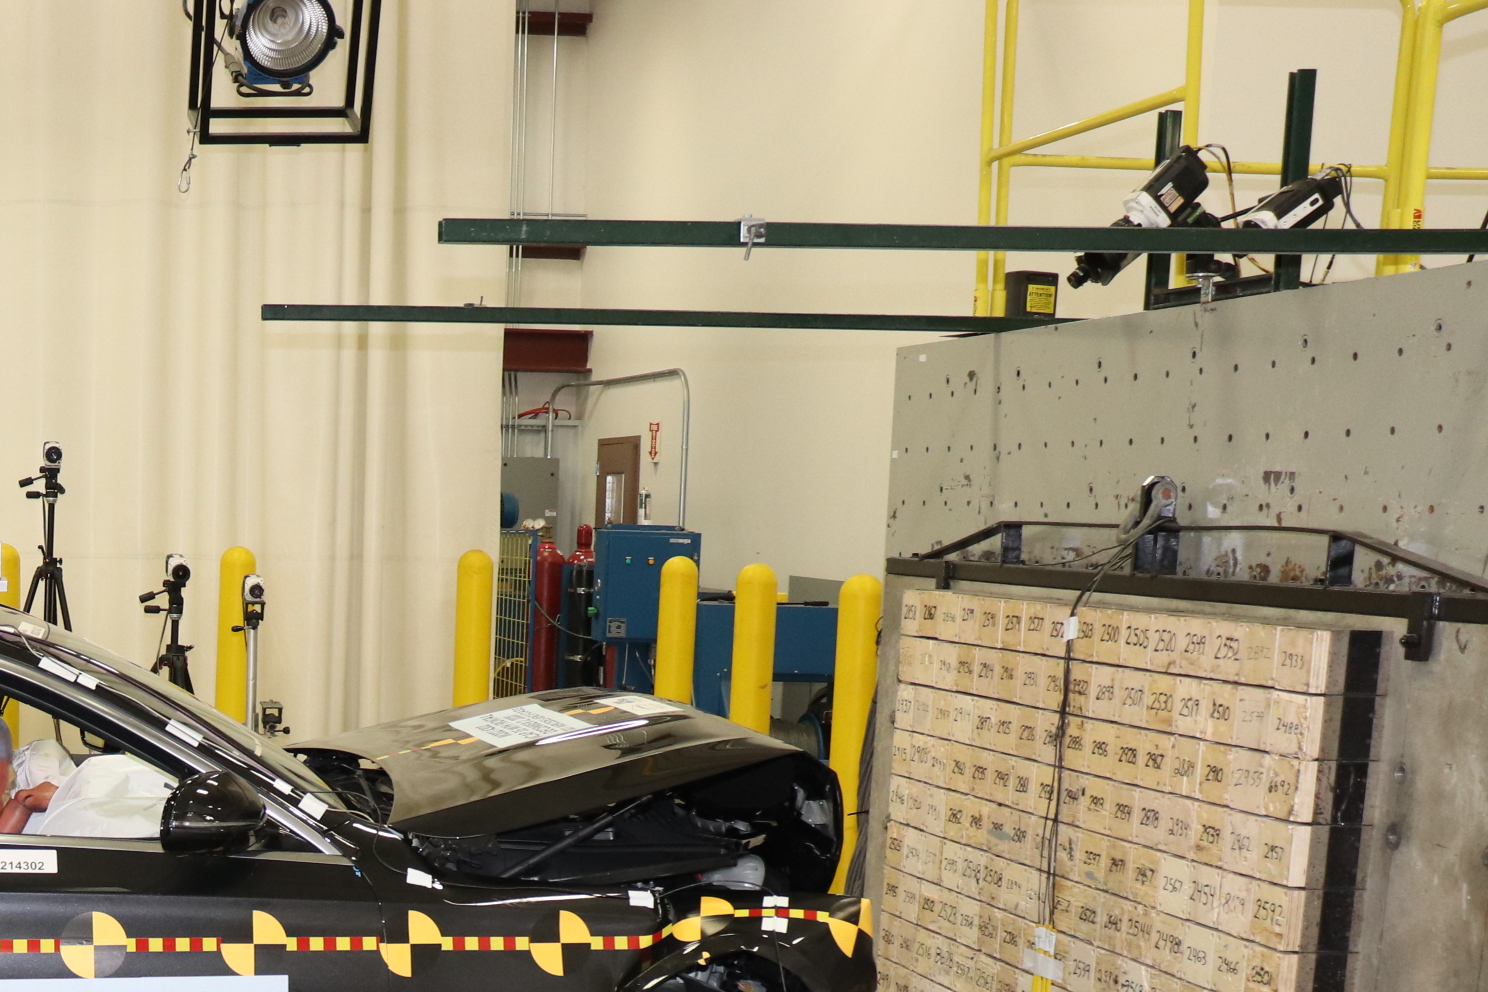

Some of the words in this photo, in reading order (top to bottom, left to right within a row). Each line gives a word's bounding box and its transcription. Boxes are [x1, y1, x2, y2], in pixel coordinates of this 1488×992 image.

[1100, 623, 1120, 643] 2500
[1125, 625, 1150, 649] 2505
[1154, 629, 1177, 653] 2520
[1214, 634, 1241, 661] 2552
[1281, 651, 1305, 670] 2933
[1150, 692, 1173, 713] 2530
[1179, 698, 1199, 717] 2519
[1118, 746, 1138, 765] 2928
[1205, 764, 1224, 783] 2910
[1234, 768, 1264, 788] 2955
[1264, 843, 1284, 861] 2957
[984, 866, 1003, 888] 2508
[1162, 876, 1183, 893] 2567
[1190, 880, 1215, 906] 2454
[938, 900, 957, 925] 2523
[1254, 899, 1285, 926] 2592
[1126, 919, 1152, 937] 2544
[916, 941, 931, 960] 2516
[1187, 946, 1207, 965] 2463
[1217, 956, 1239, 975] 2466
